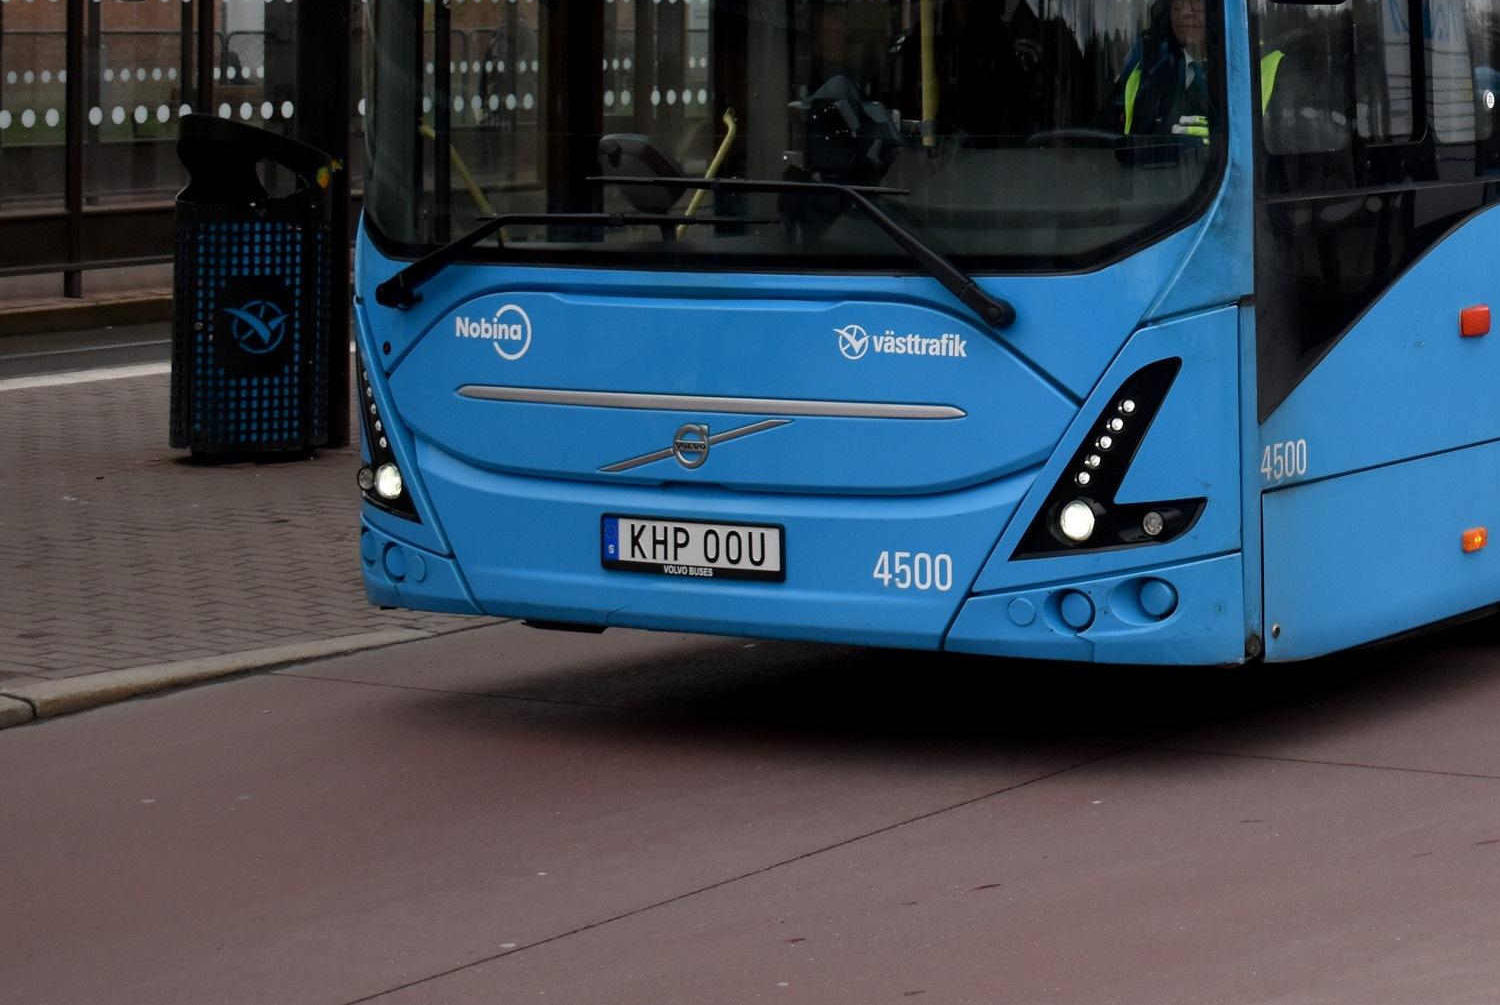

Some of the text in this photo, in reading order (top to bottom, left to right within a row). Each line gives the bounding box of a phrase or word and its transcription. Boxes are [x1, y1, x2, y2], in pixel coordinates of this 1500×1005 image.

[455, 316, 522, 340] Nobina
[872, 330, 967, 357] västtrafik
[1260, 439, 1307, 480] 4500
[608, 544, 615, 554] S
[630, 524, 690, 561] KHP
[664, 565, 713, 577] VOLVO BUSES
[872, 550, 954, 592] 4500
